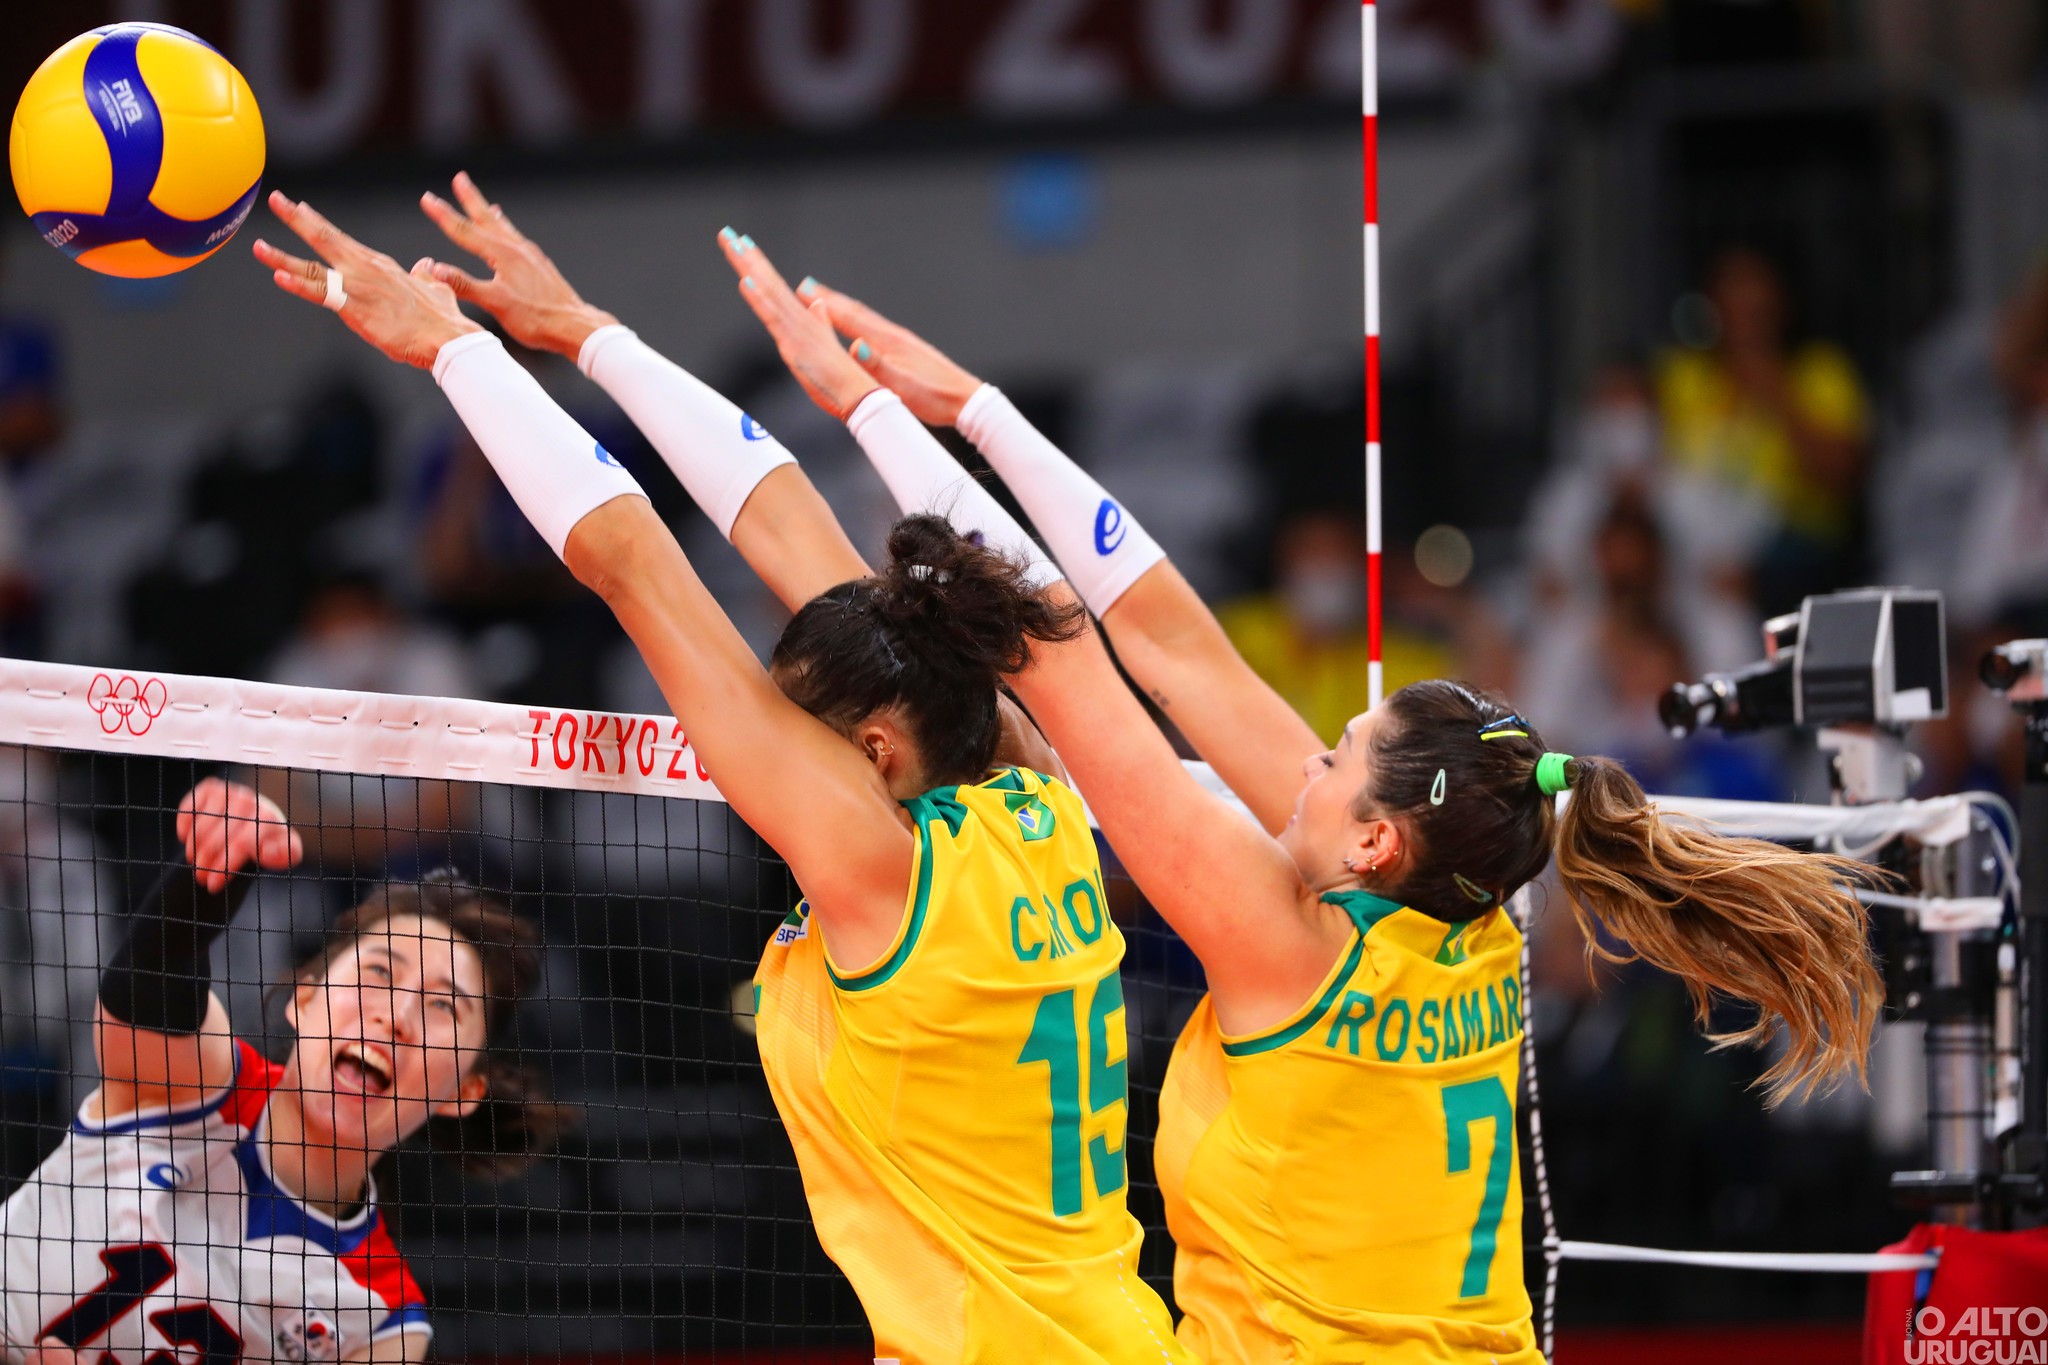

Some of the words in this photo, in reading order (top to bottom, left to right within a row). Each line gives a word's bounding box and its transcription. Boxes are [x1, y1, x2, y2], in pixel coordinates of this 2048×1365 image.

[112, 0, 918, 162] OKYO
[528, 710, 659, 776] TOKYO
[776, 928, 805, 943] BR
[1017, 972, 1128, 1217] 15
[1441, 1074, 1513, 1298] 7
